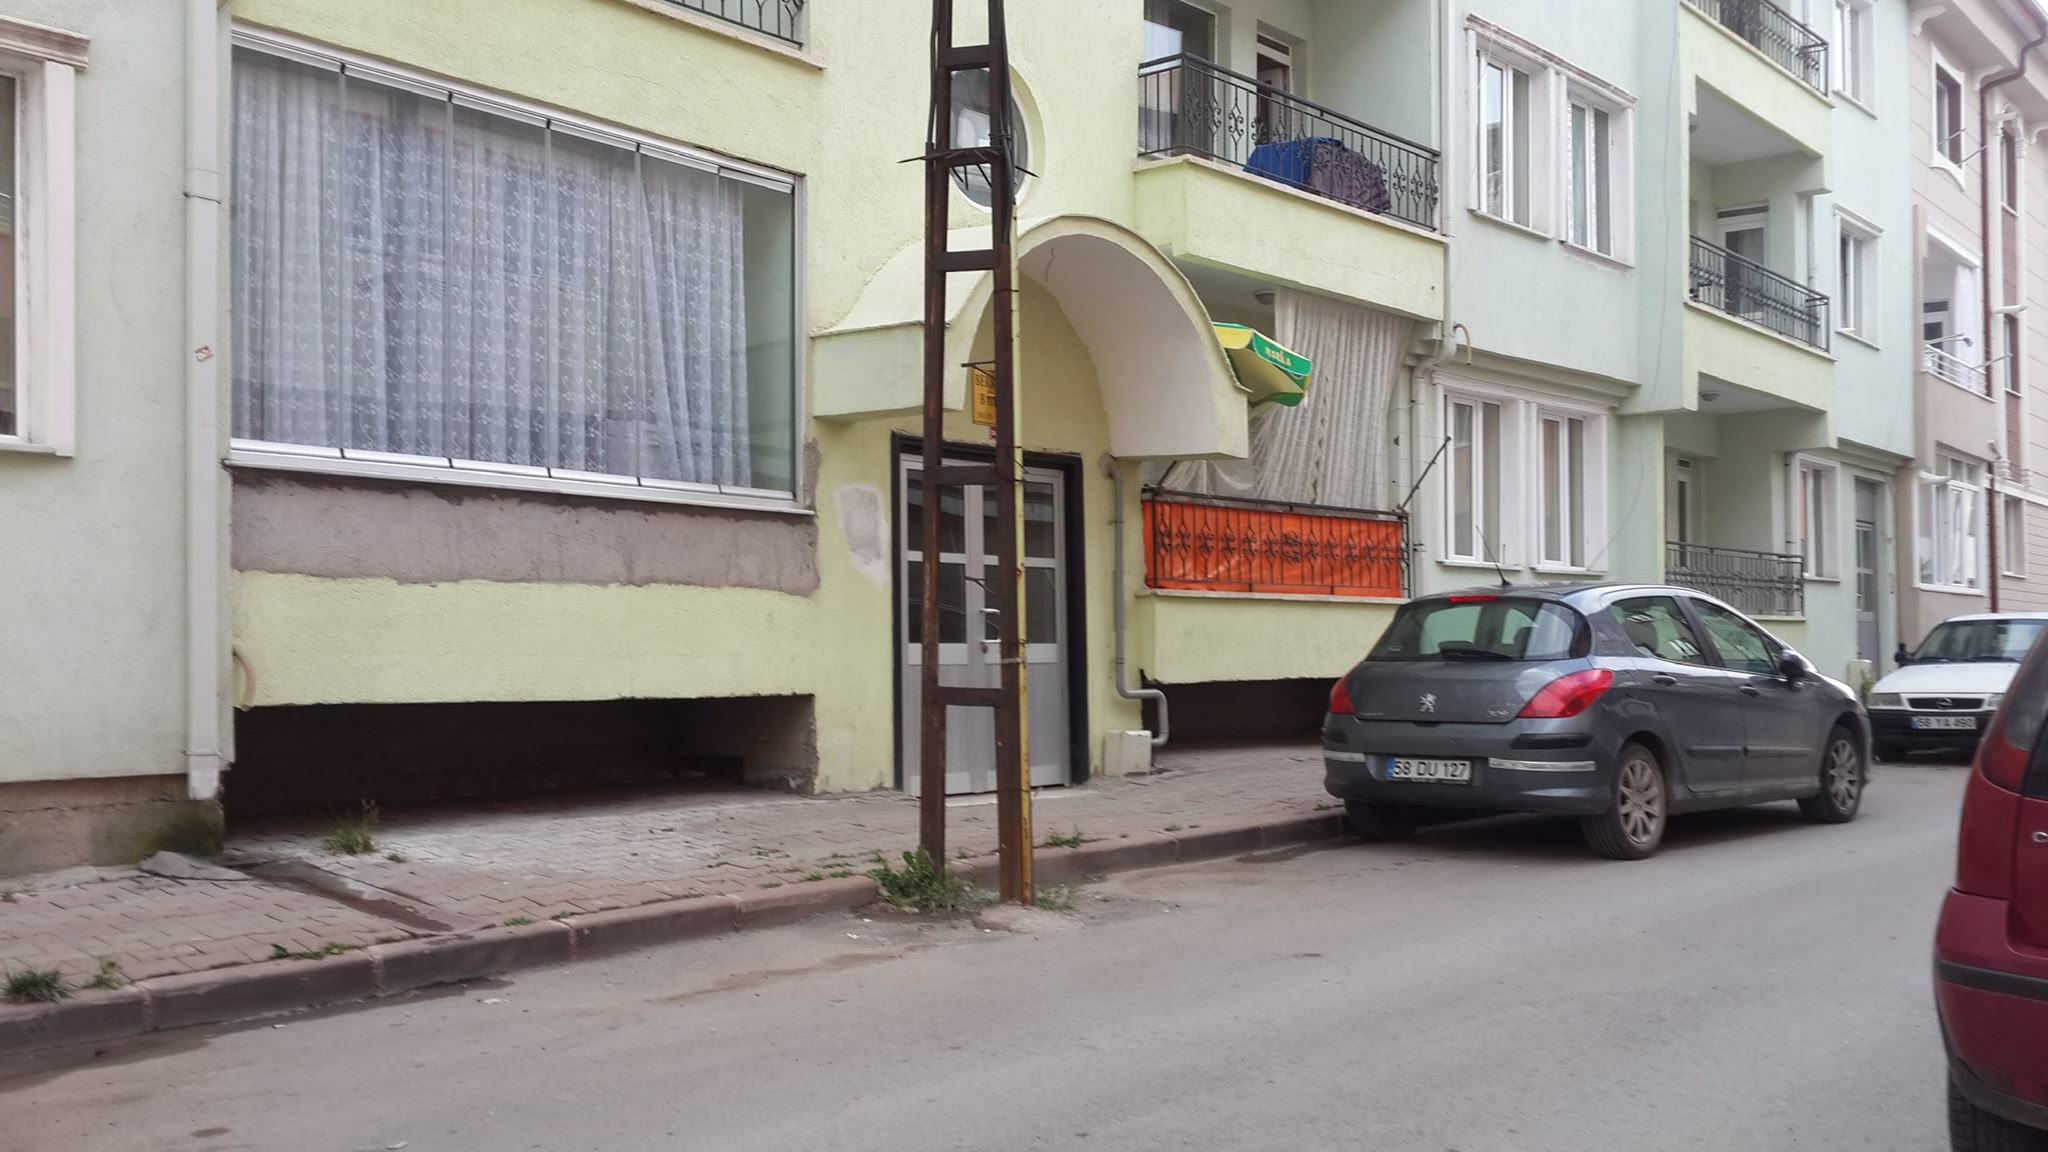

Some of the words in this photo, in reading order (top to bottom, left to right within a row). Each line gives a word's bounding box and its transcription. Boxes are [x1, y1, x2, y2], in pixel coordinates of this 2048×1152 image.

[1393, 760, 1412, 776] 58
[1416, 761, 1438, 777] DU
[1443, 762, 1467, 778] 127
